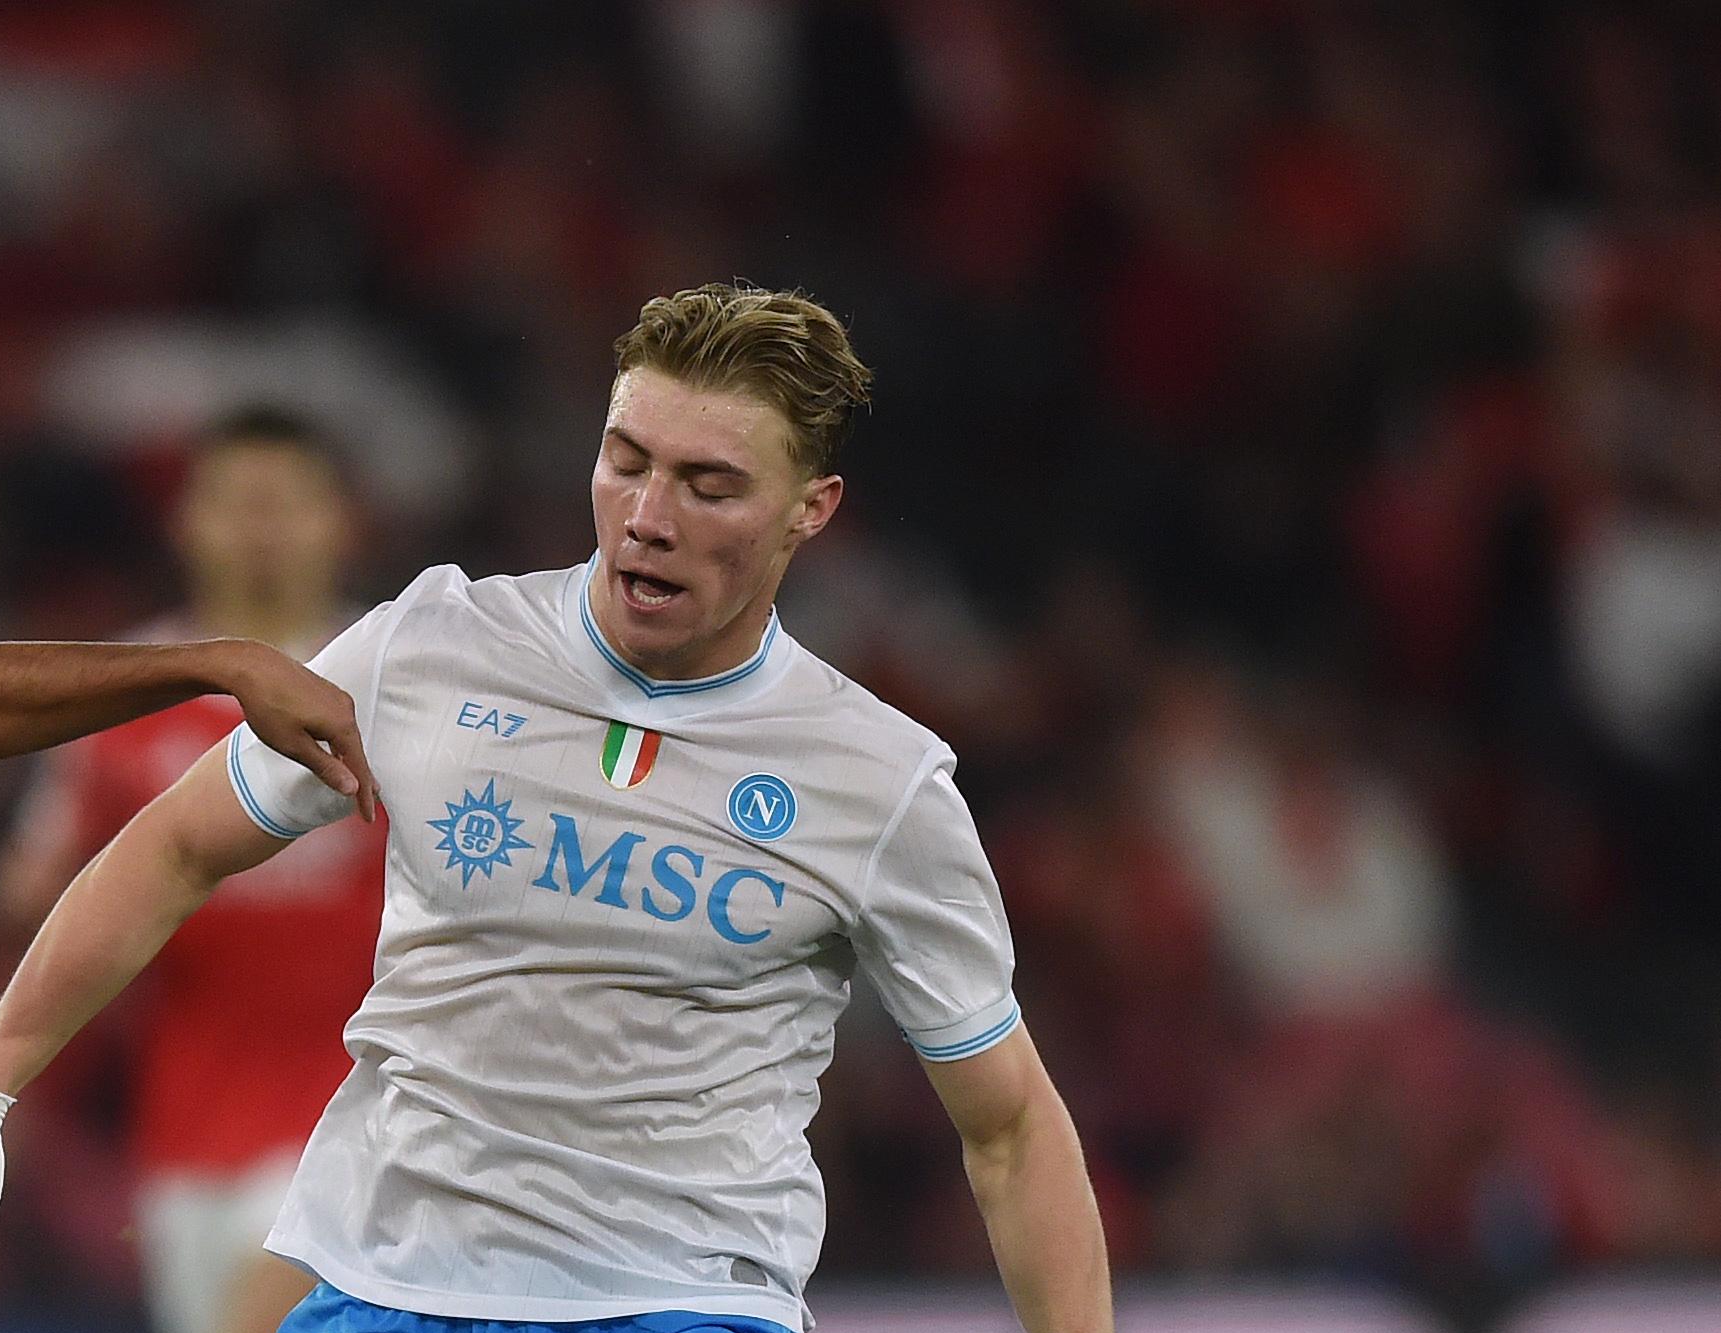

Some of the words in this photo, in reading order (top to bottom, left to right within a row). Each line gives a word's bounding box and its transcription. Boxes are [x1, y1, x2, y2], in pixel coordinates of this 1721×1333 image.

[457, 701, 528, 738] EA7
[743, 789, 781, 826] N
[532, 812, 785, 944] MSC
